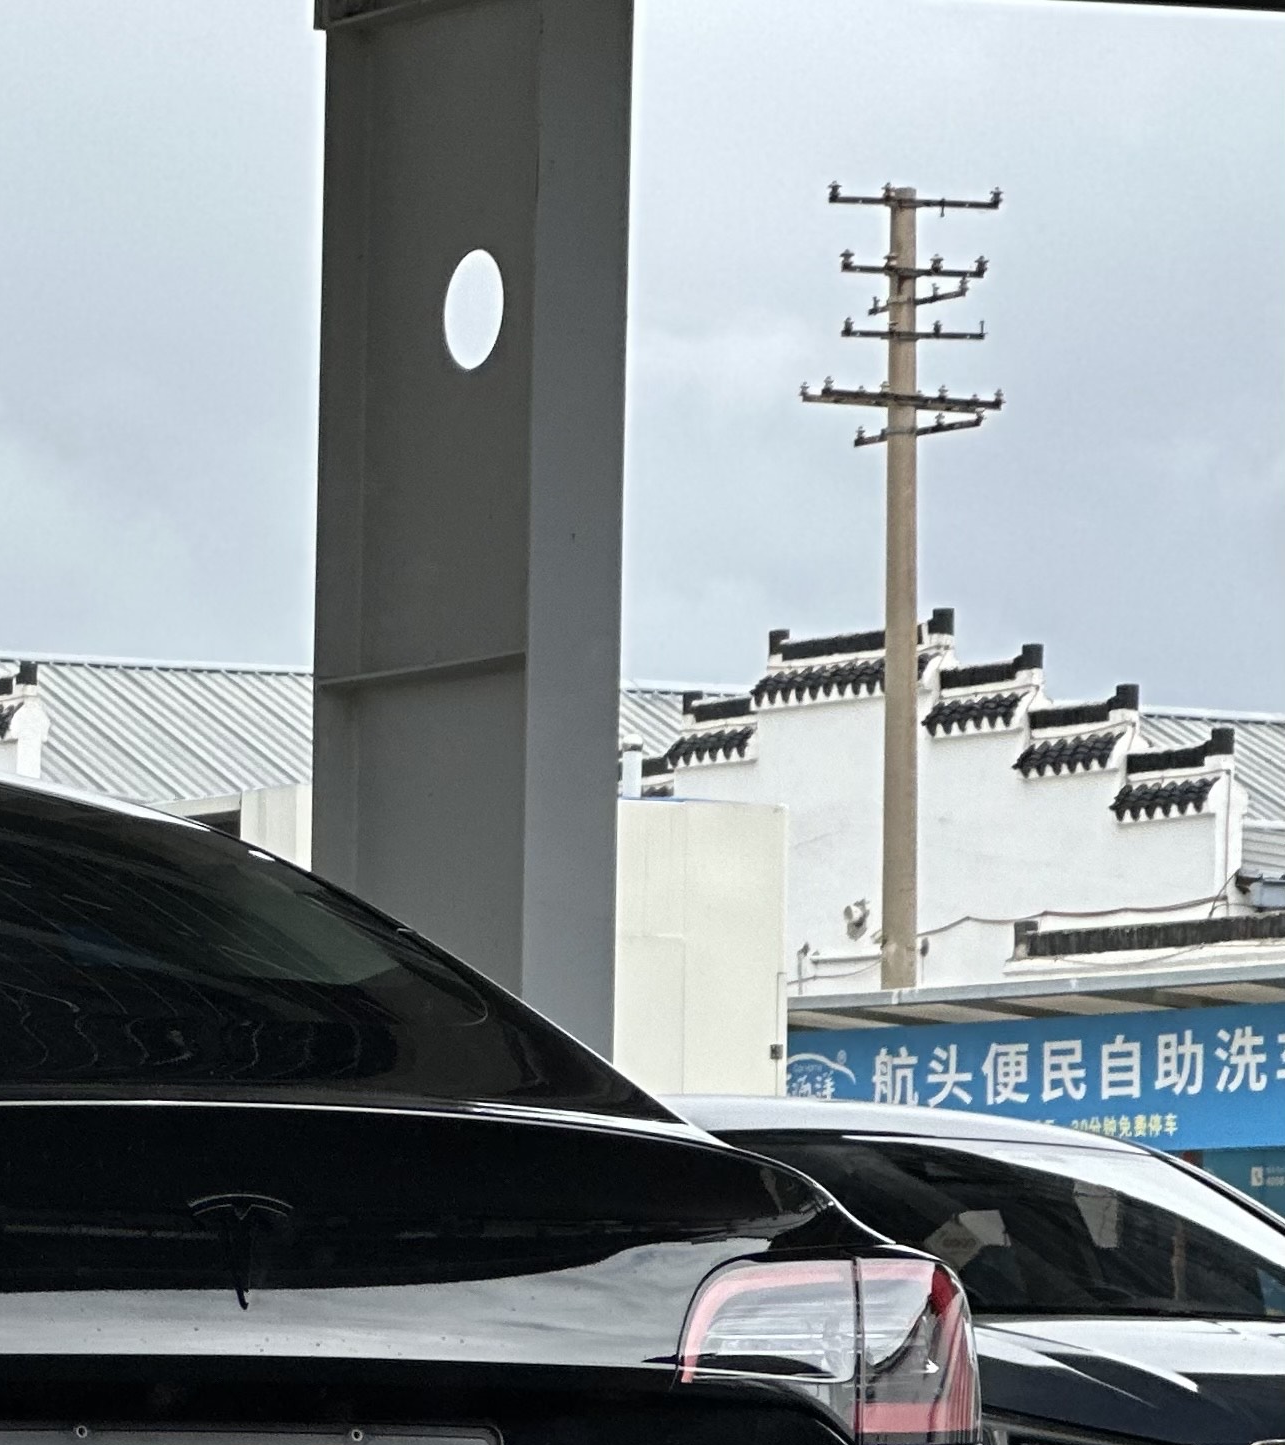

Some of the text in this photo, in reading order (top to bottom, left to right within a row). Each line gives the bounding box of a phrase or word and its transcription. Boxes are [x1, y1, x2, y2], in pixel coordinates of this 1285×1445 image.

[871, 1026, 1285, 1107] 航头便民自助洗
